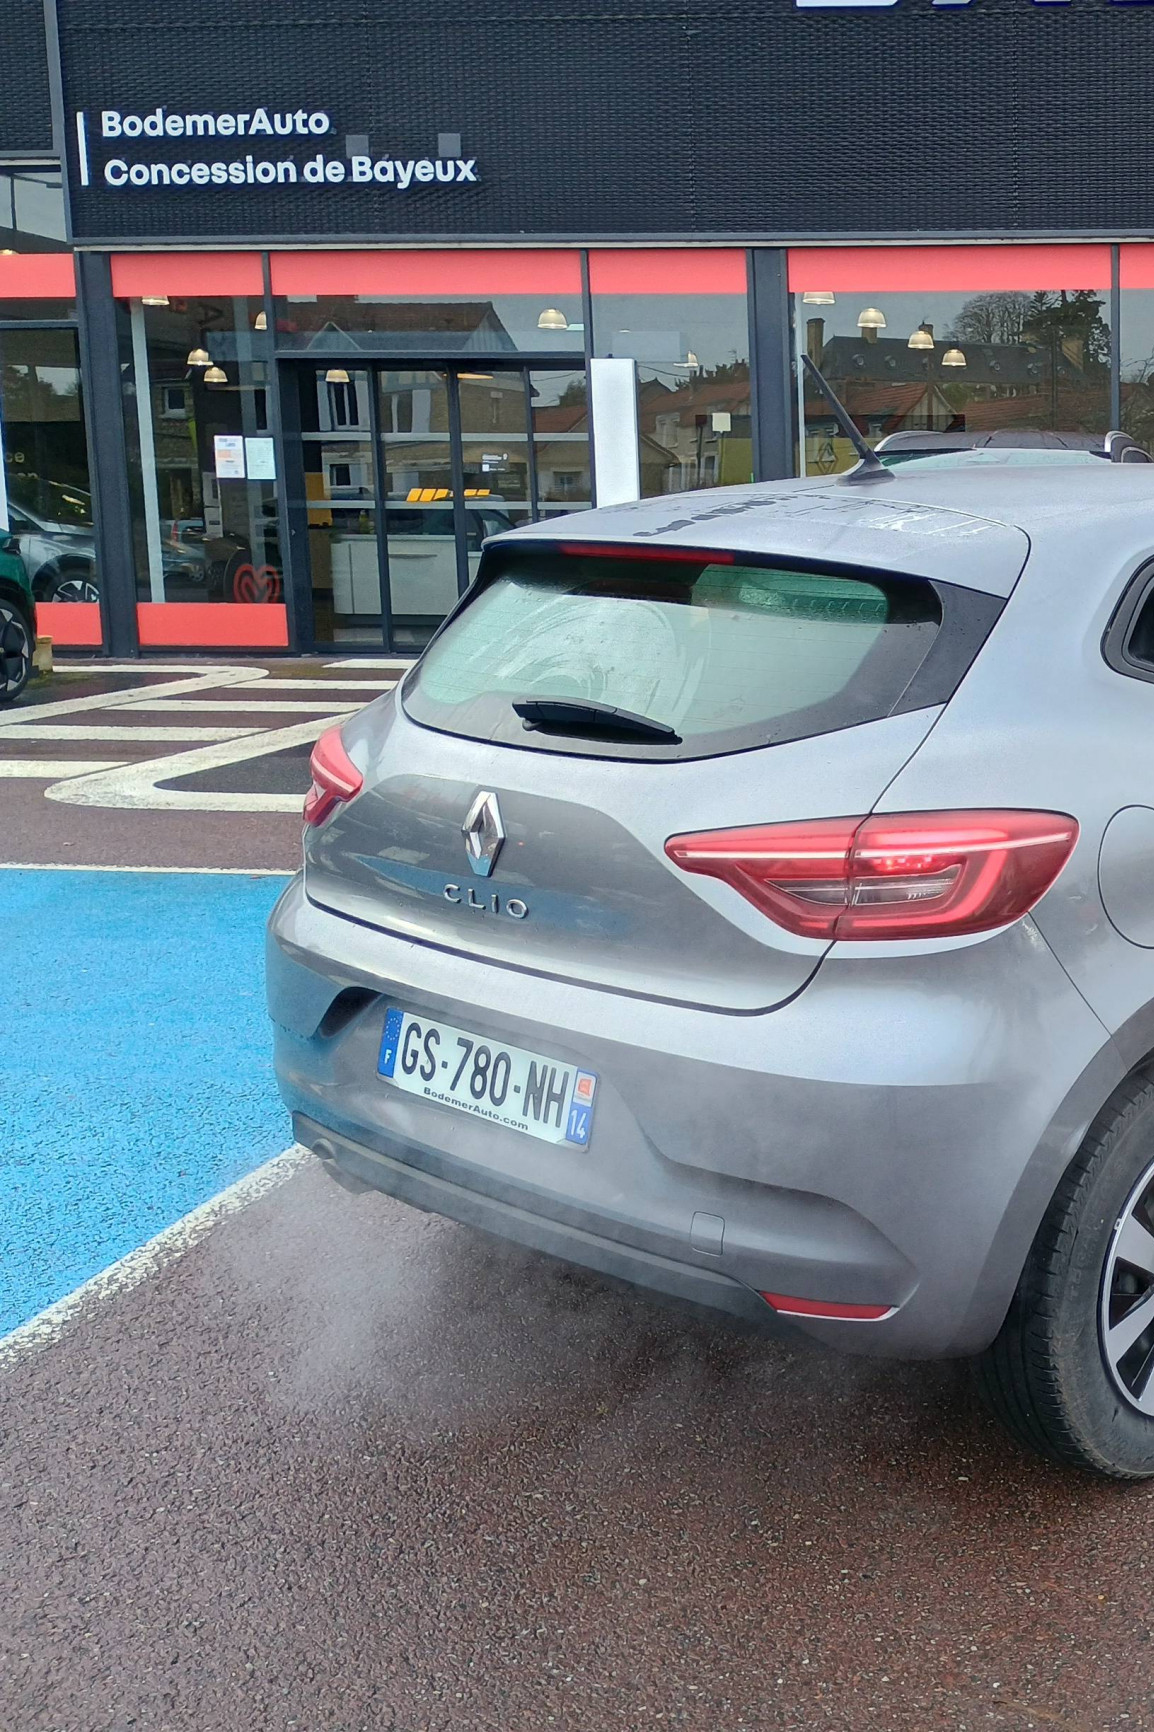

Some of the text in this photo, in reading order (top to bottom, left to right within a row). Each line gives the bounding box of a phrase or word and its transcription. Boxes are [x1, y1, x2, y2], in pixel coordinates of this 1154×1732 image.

[101, 107, 331, 137] BodemerAuto
[104, 154, 477, 189] Concession de Bayeux
[443, 883, 529, 919] CLIO
[384, 1049, 392, 1064] F
[401, 1022, 569, 1128] GS-780-NH
[423, 1086, 529, 1131] BodemerAuto.com
[570, 1109, 586, 1139] 14
